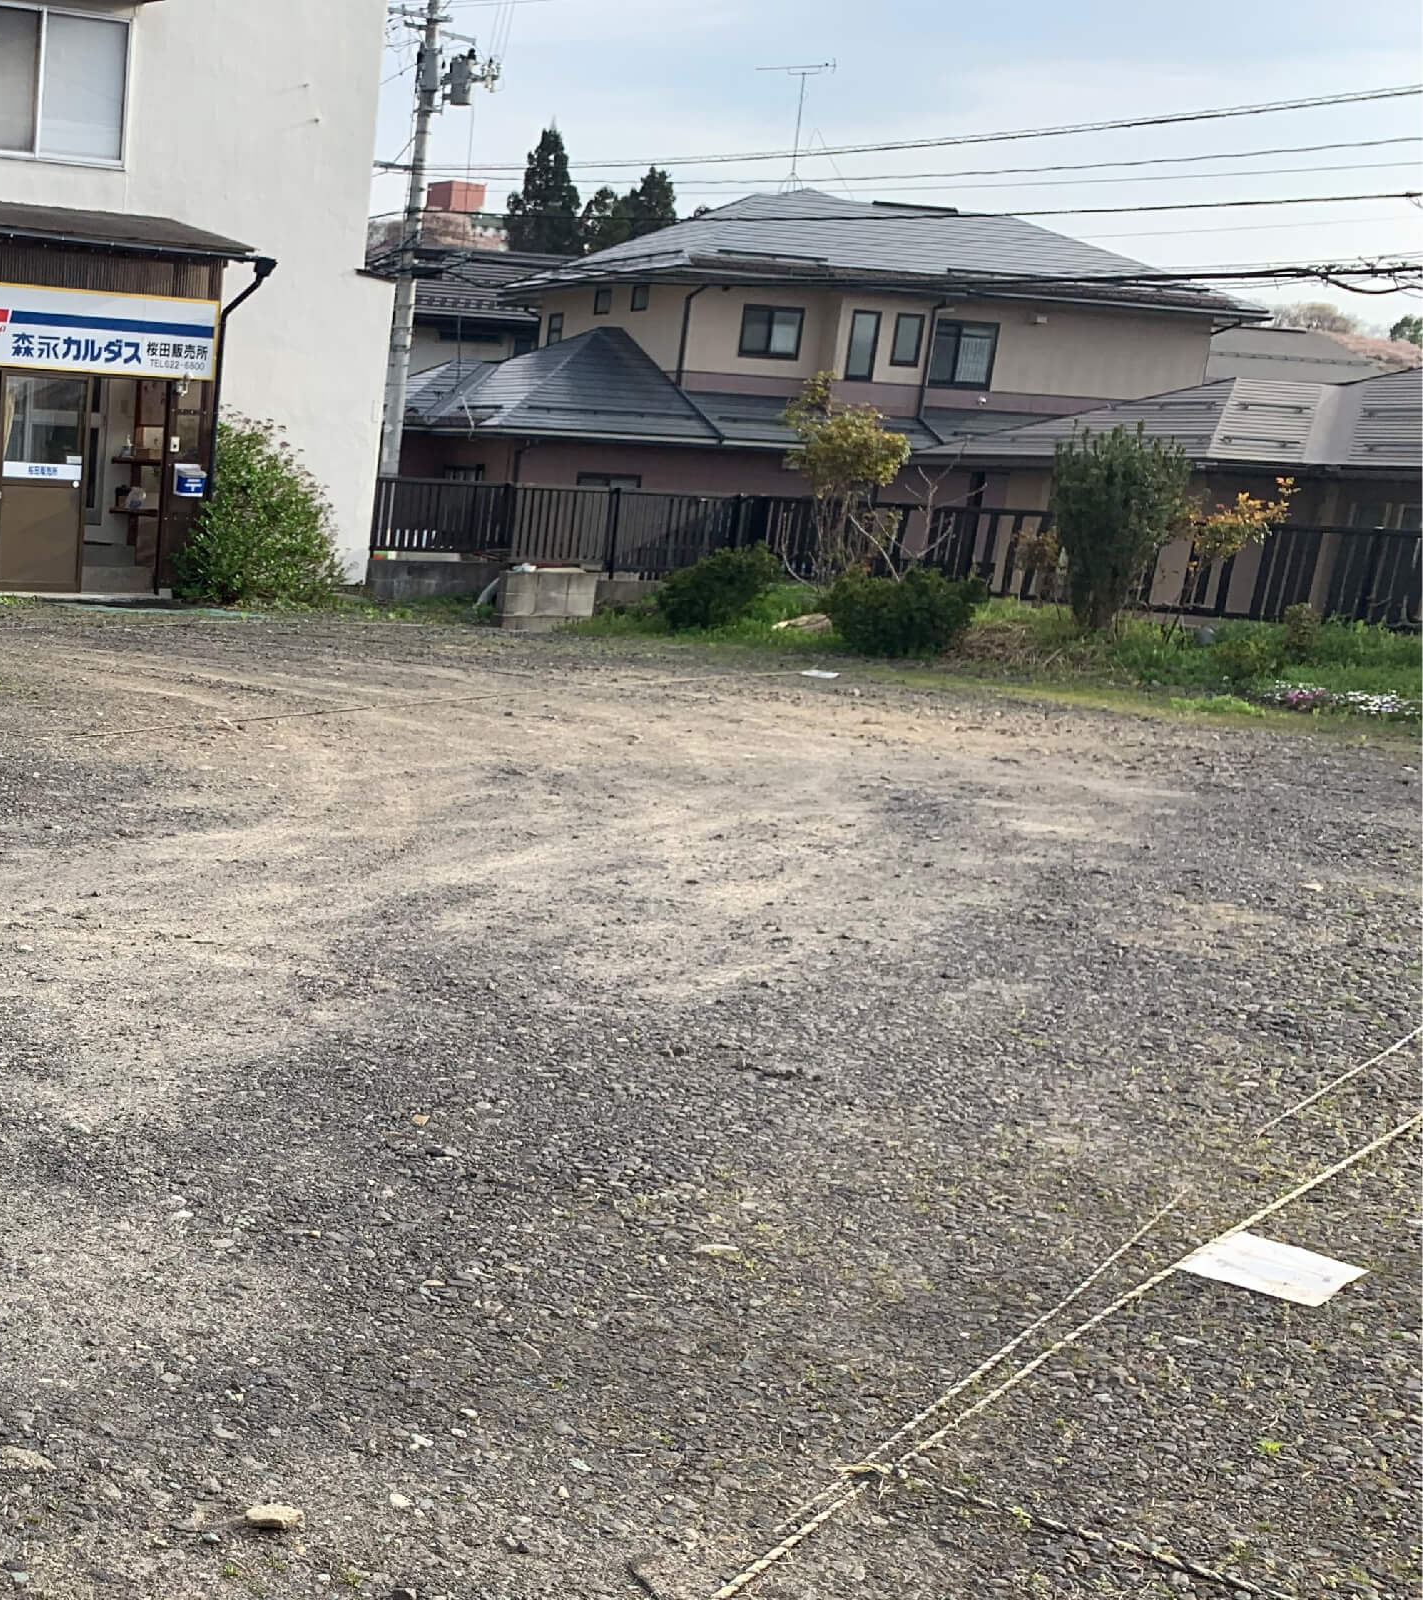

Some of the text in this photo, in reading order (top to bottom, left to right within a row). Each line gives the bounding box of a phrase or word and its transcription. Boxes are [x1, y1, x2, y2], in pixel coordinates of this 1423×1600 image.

[11, 332, 142, 365] 森永カルダス
[146, 341, 208, 361] 桜田販売所
